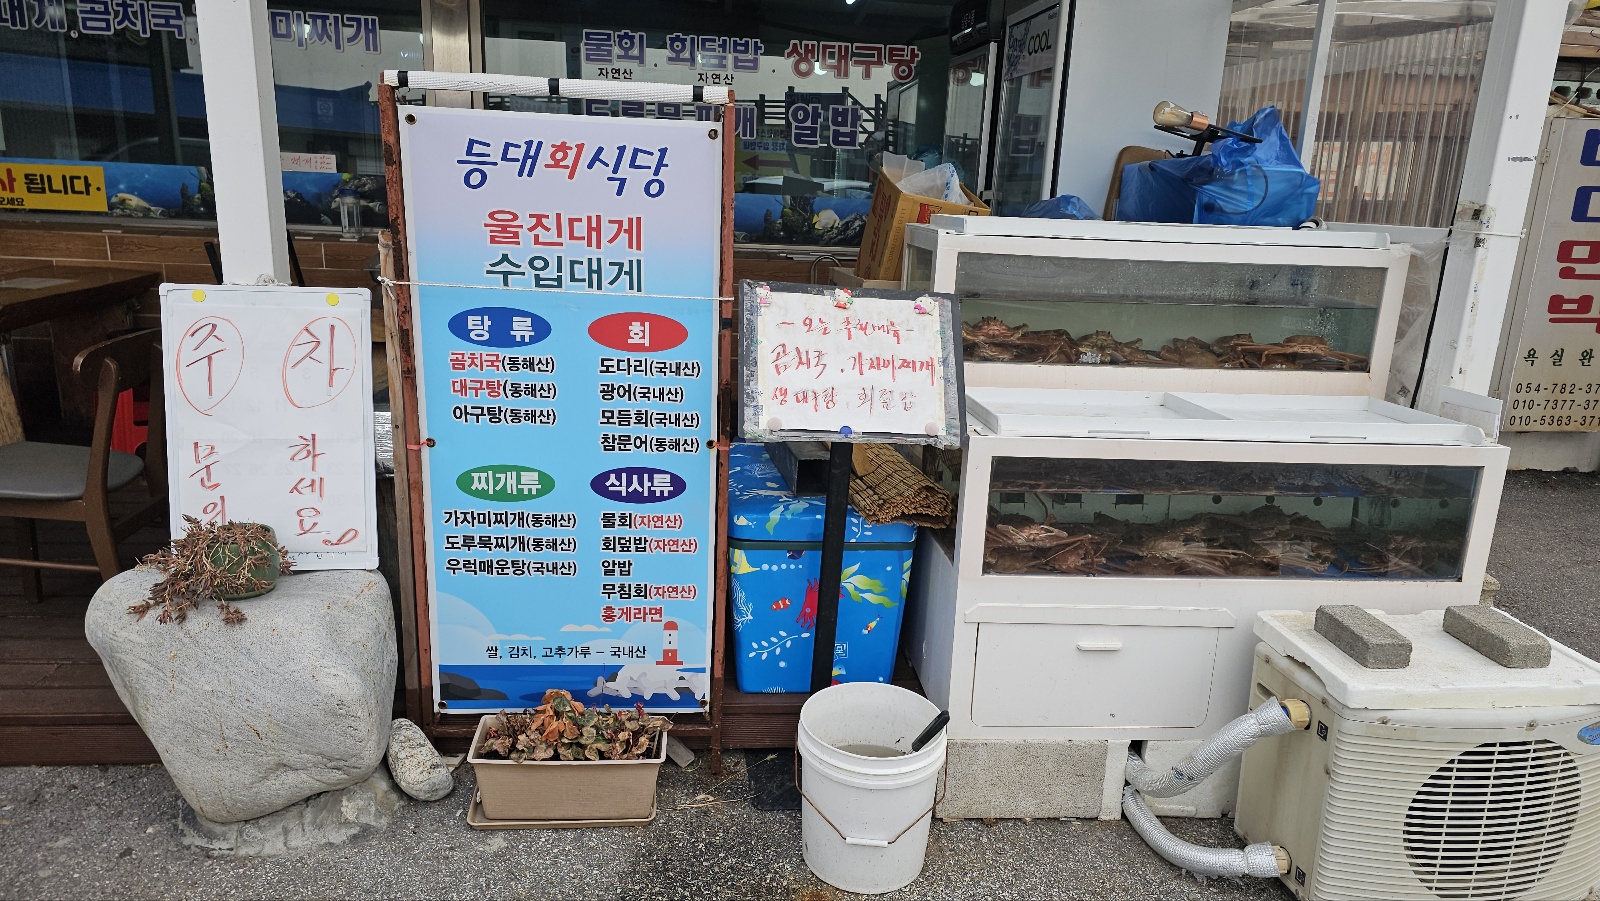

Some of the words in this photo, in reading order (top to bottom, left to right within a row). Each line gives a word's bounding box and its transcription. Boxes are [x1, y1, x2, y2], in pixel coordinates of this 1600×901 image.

[1028, 29, 1052, 56] COOL
[582, 29, 647, 66] 물회
[666, 33, 764, 73] 회덮밥
[785, 40, 921, 82] 생대구탕
[597, 67, 633, 80] 자연산
[697, 73, 734, 85] 자연산
[789, 104, 864, 149] 알밥
[457, 138, 669, 198] 등대회식당
[484, 209, 642, 251] 울진대게
[486, 253, 642, 292] 수입대게
[627, 321, 650, 347] 회
[449, 352, 555, 374] 곰치국(동해산)
[599, 357, 701, 378] 도다리(국내산)
[770, 343, 828, 379] 곰치국
[451, 379, 557, 399] 대구탕(동해산)
[599, 383, 685, 402] 광어(국내산)
[452, 405, 557, 425] 아구탕(동해산)
[599, 409, 700, 429] 모듬회(국내산)
[600, 434, 700, 453] 참문어(동해산)
[471, 471, 541, 495] 찌개류
[605, 473, 674, 496] 식사류
[443, 510, 577, 529] 가자미찌개(동해산)
[601, 512, 683, 530] 물회(자연산)
[444, 534, 577, 552] 도루묵찌개(동해산)
[601, 536, 698, 553] 회덮밥(자연산)
[445, 559, 577, 577] 우럭매운탕(국내산)
[601, 560, 632, 577] 알밥
[601, 583, 697, 600] 무침회(자연산)
[601, 606, 664, 623] 홍게라면
[541, 646, 591, 659] 고추가루
[610, 646, 647, 659] 국내산
